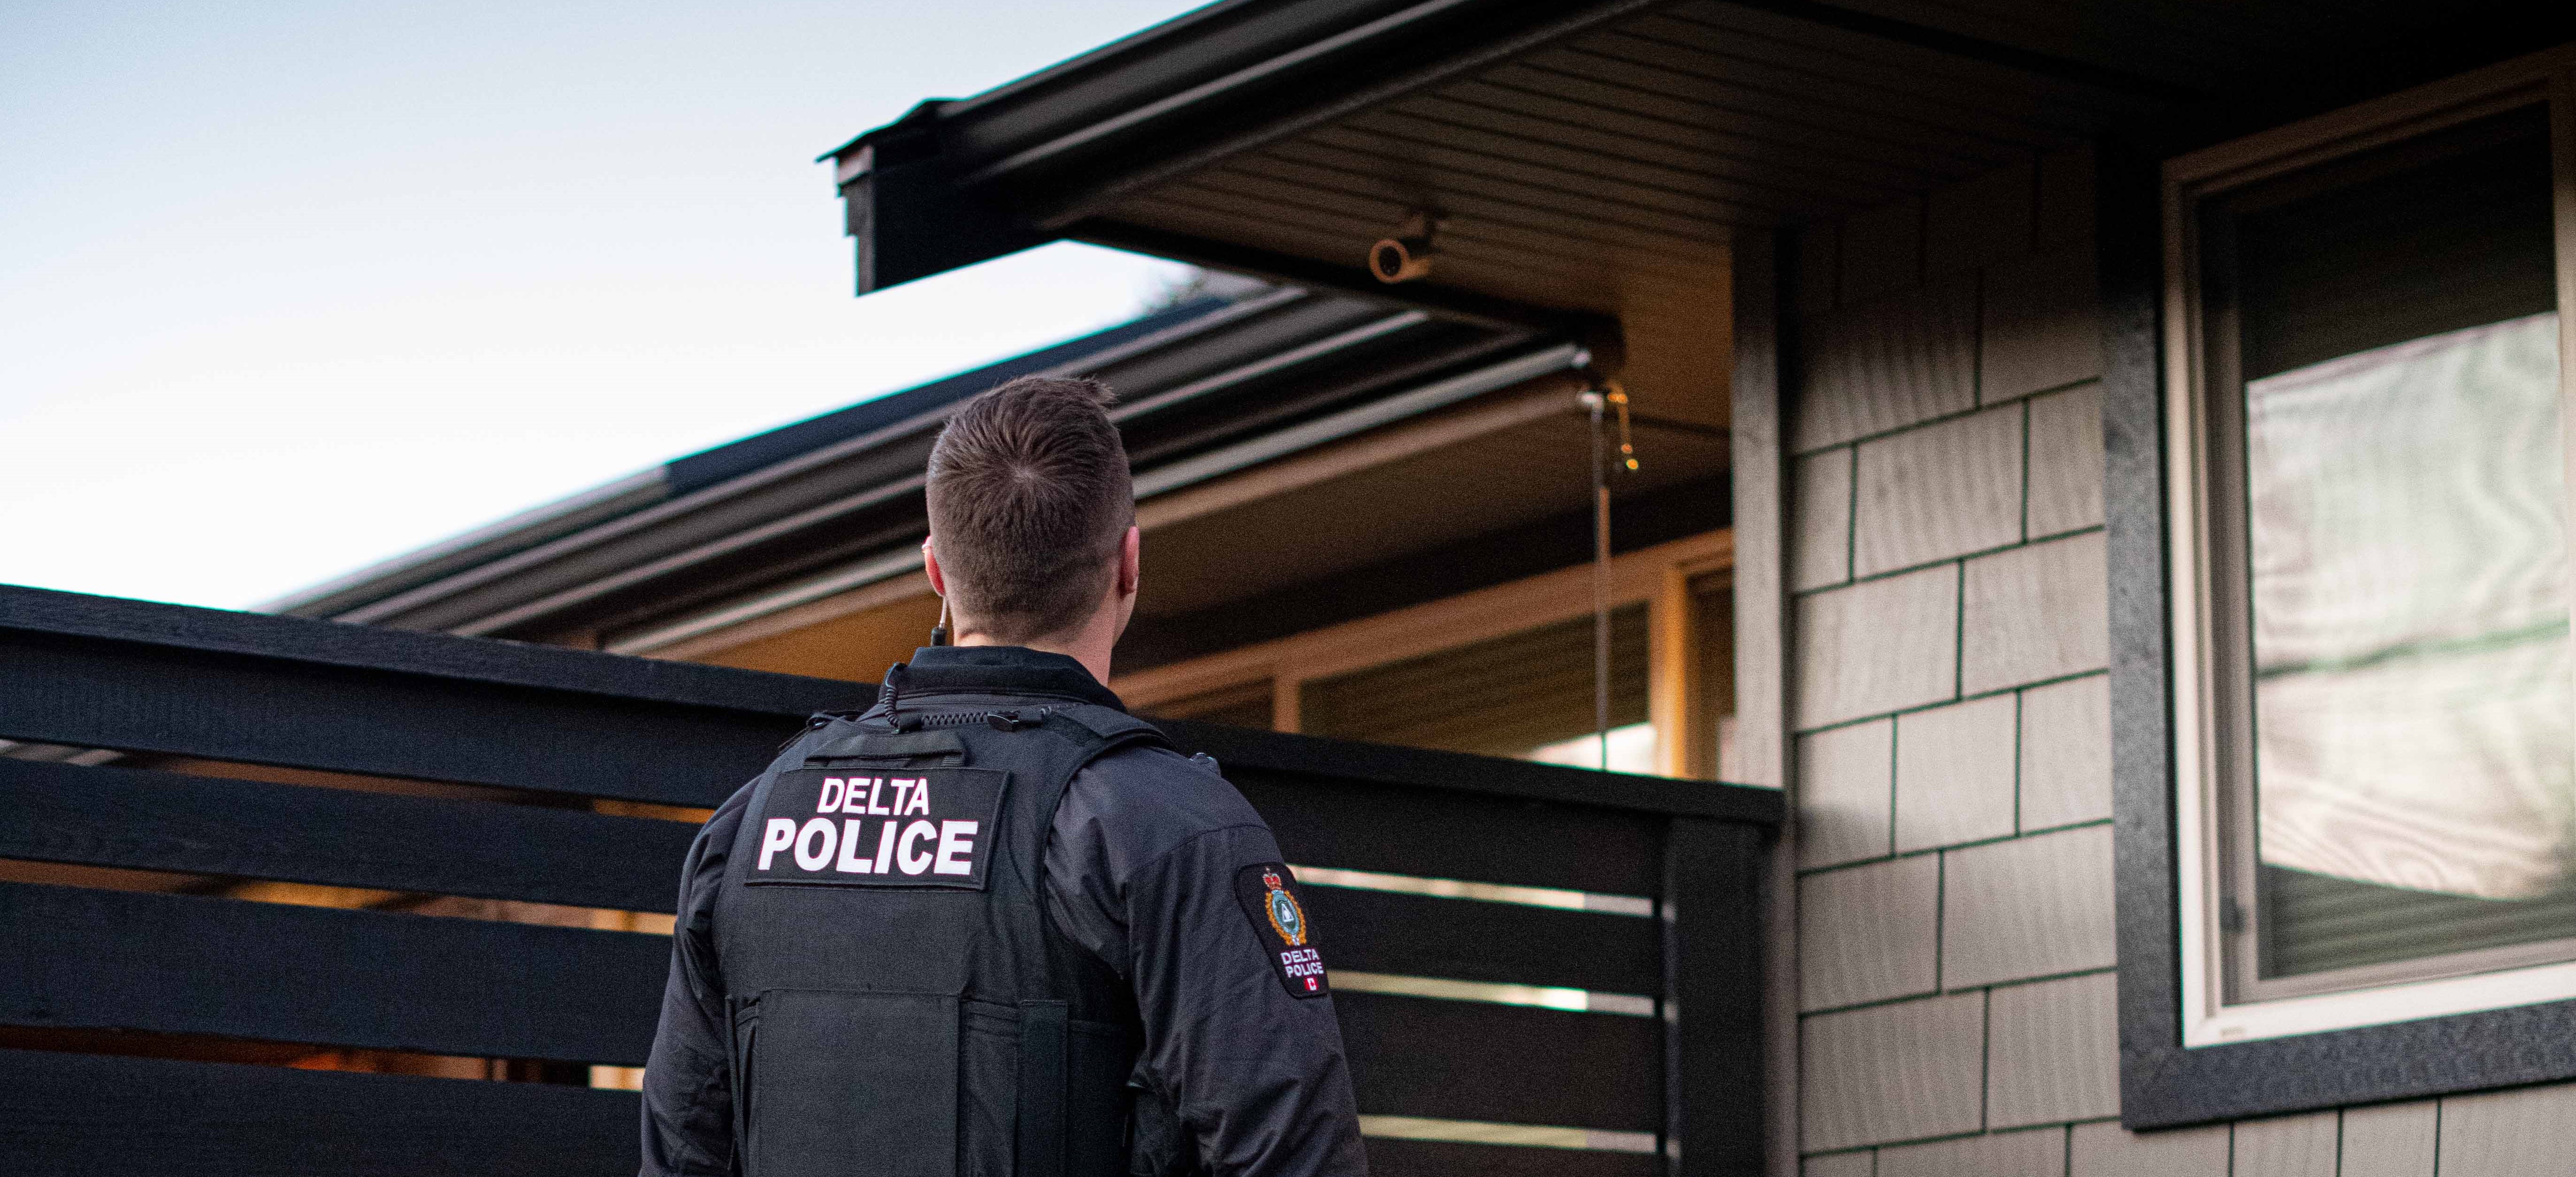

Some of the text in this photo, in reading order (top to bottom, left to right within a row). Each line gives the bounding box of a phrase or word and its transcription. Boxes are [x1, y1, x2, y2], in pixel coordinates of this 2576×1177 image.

[817, 778, 929, 816] DELTA
[758, 818, 978, 875] POLICE
[1281, 949, 1319, 964] DELTA
[1285, 963, 1324, 978] POLICE
